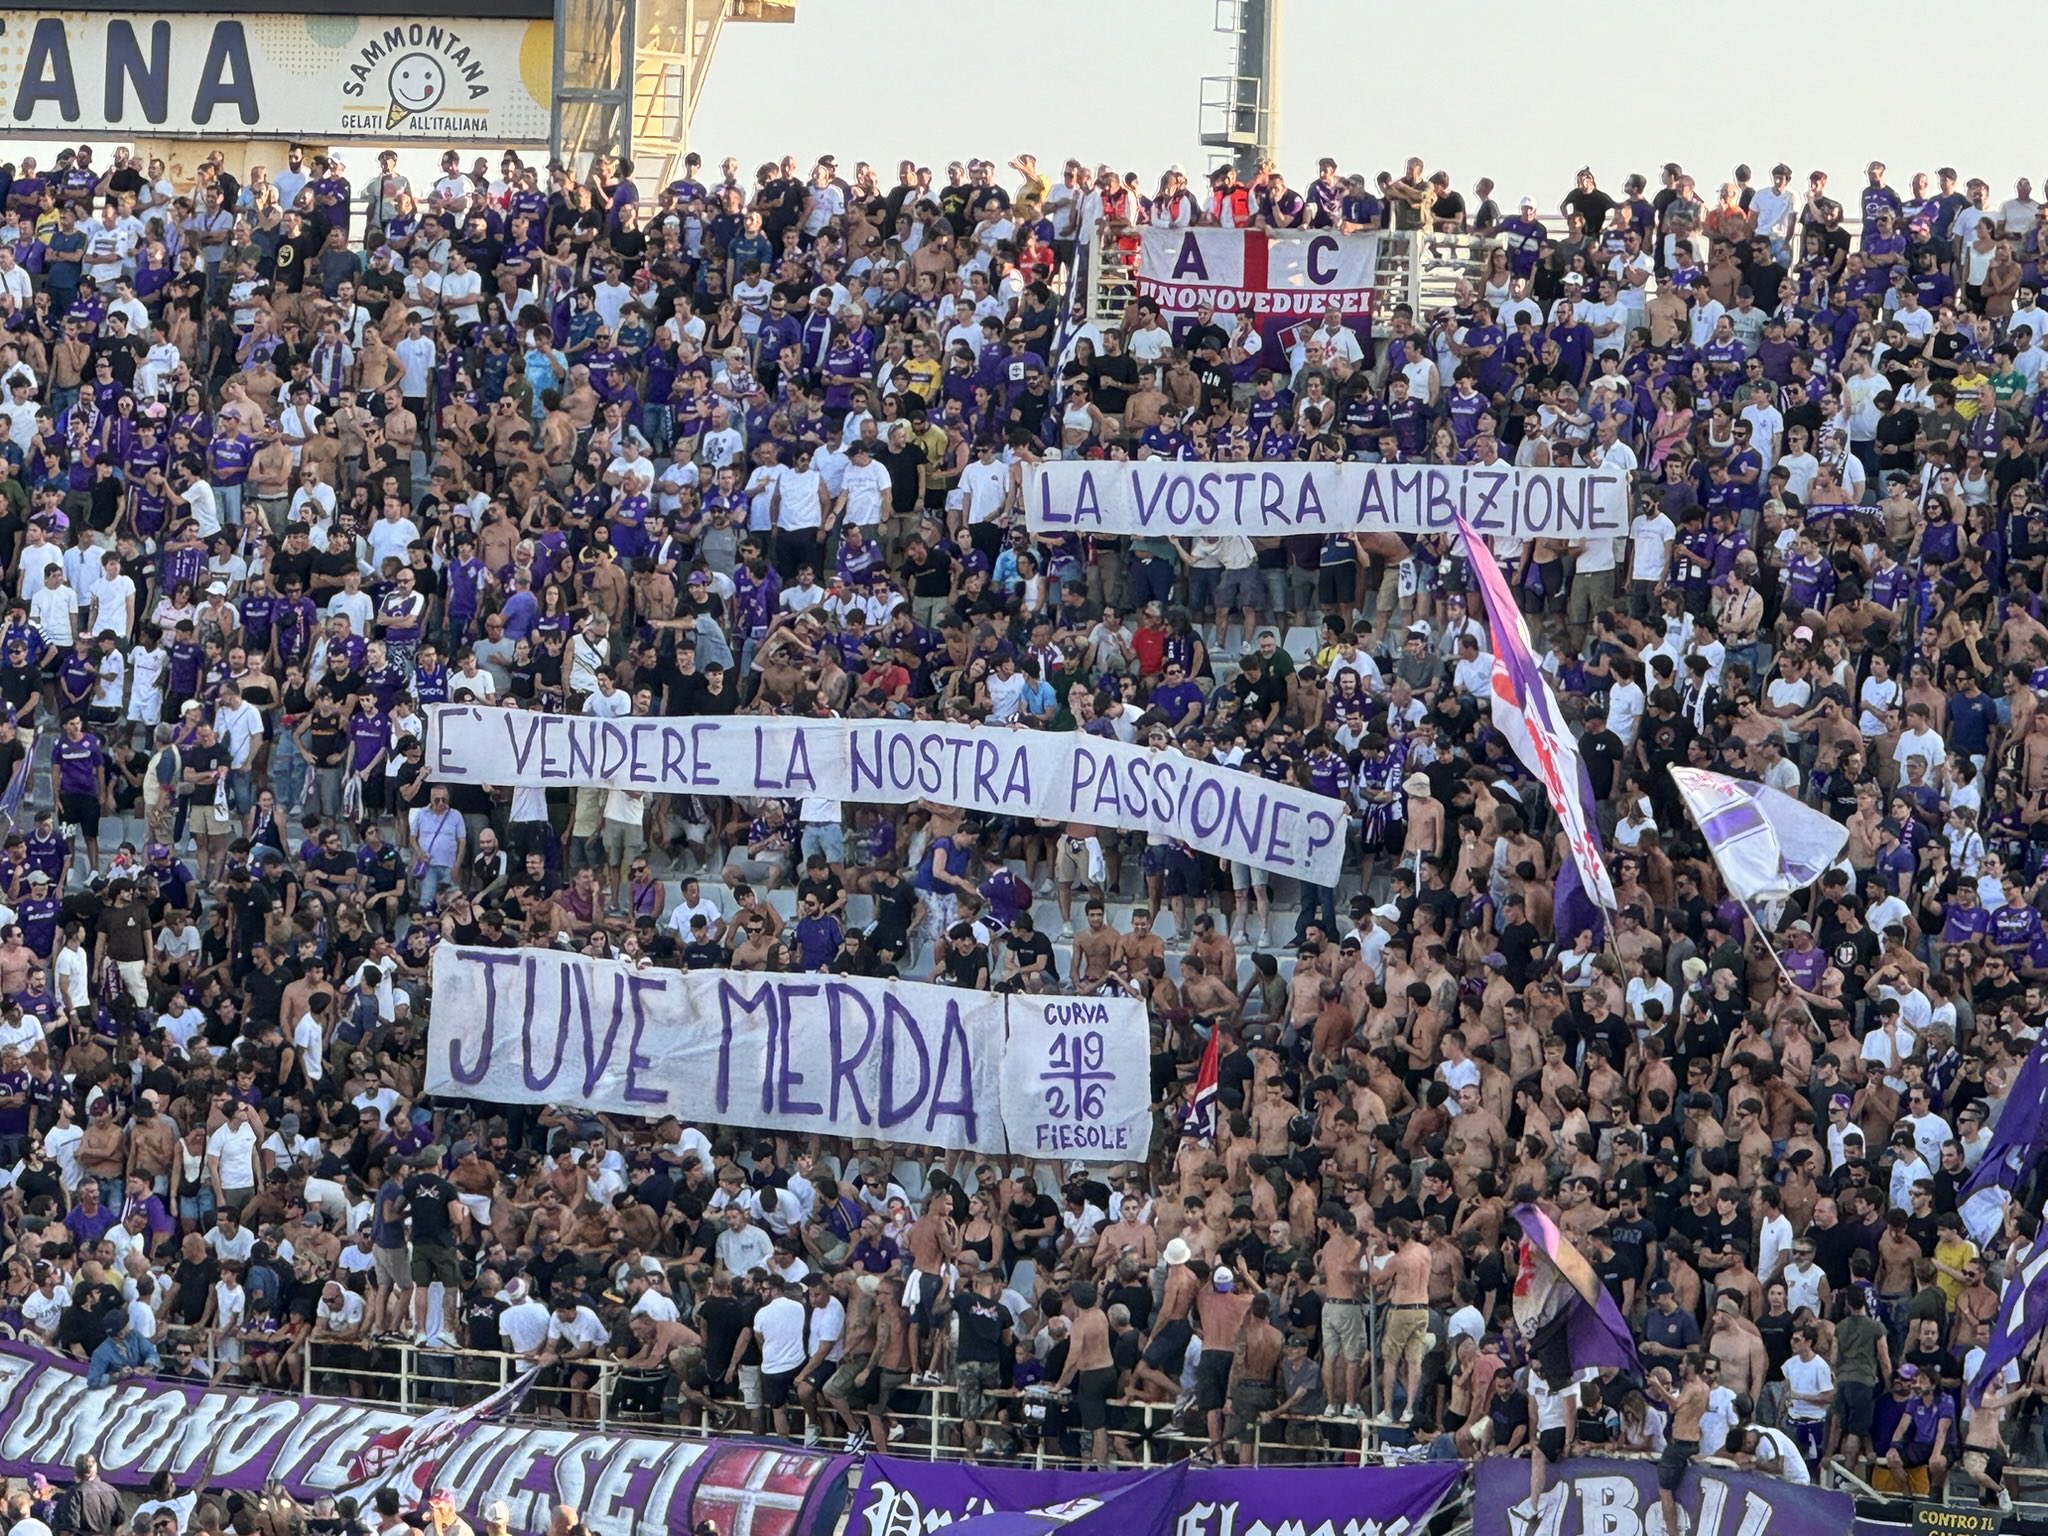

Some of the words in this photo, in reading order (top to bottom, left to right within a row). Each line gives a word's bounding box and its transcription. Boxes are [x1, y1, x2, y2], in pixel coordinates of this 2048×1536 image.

[0, 18, 260, 125] ANA
[343, 24, 489, 99] SAMMONTANA
[341, 115, 382, 129] GELATI
[410, 117, 488, 131] ALL'ITALIANA
[1172, 231, 1209, 281] A
[1307, 235, 1339, 285] C
[1042, 470, 1101, 525] LA
[1132, 470, 1326, 526] VOSTRA
[504, 712, 721, 786] VENDERE
[754, 725, 817, 791] LA
[851, 729, 1031, 805] NOSTRA
[450, 950, 669, 1103] JUVE
[716, 977, 977, 1143] MERDA
[1044, 1002, 1110, 1026] CURVA
[2, 1367, 708, 1536] UNONOVEUESEI
[1918, 1510, 1978, 1530] CONTRO
[1980, 1517, 1995, 1531] IL
